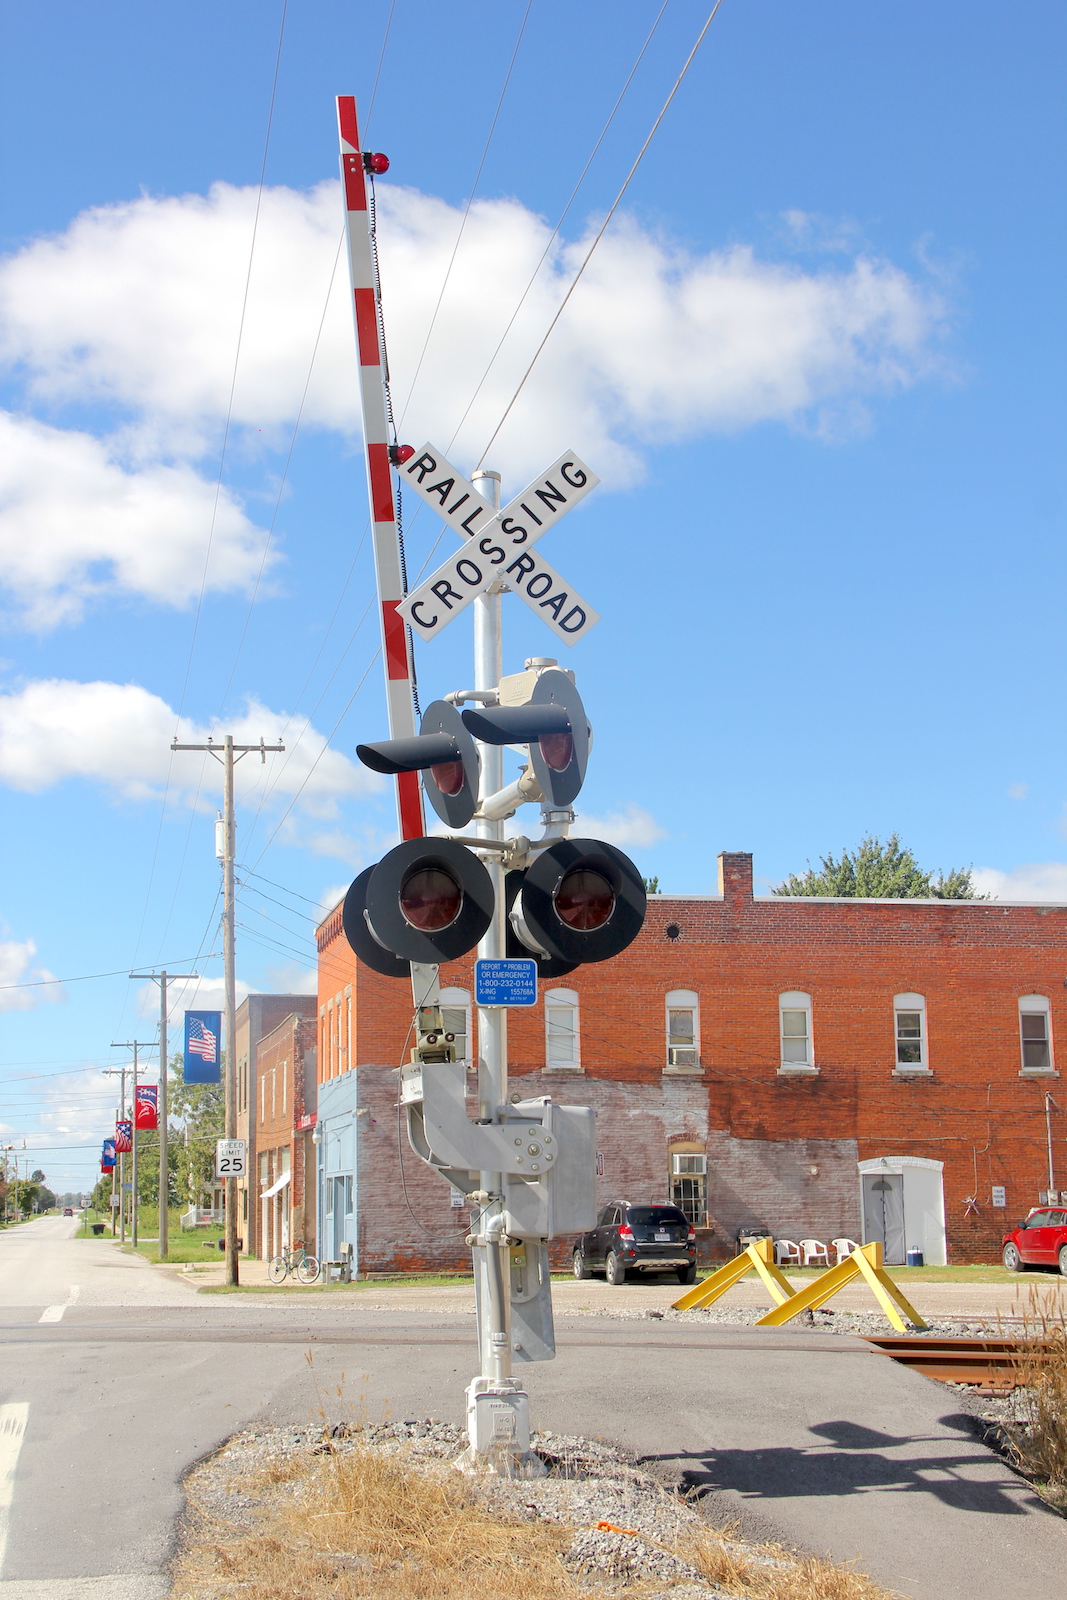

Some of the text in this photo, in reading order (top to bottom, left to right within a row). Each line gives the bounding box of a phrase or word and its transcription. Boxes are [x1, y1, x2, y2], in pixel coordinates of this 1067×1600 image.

[407, 452, 484, 537] RAIL
[410, 461, 588, 629] CROSSING
[505, 552, 587, 633] ROAD
[481, 963, 531, 971] REPORT PROBLEM
[492, 971, 531, 979] EMERGENCY
[479, 979, 533, 987] 1-800-232-0144
[220, 1158, 243, 1172] 25
